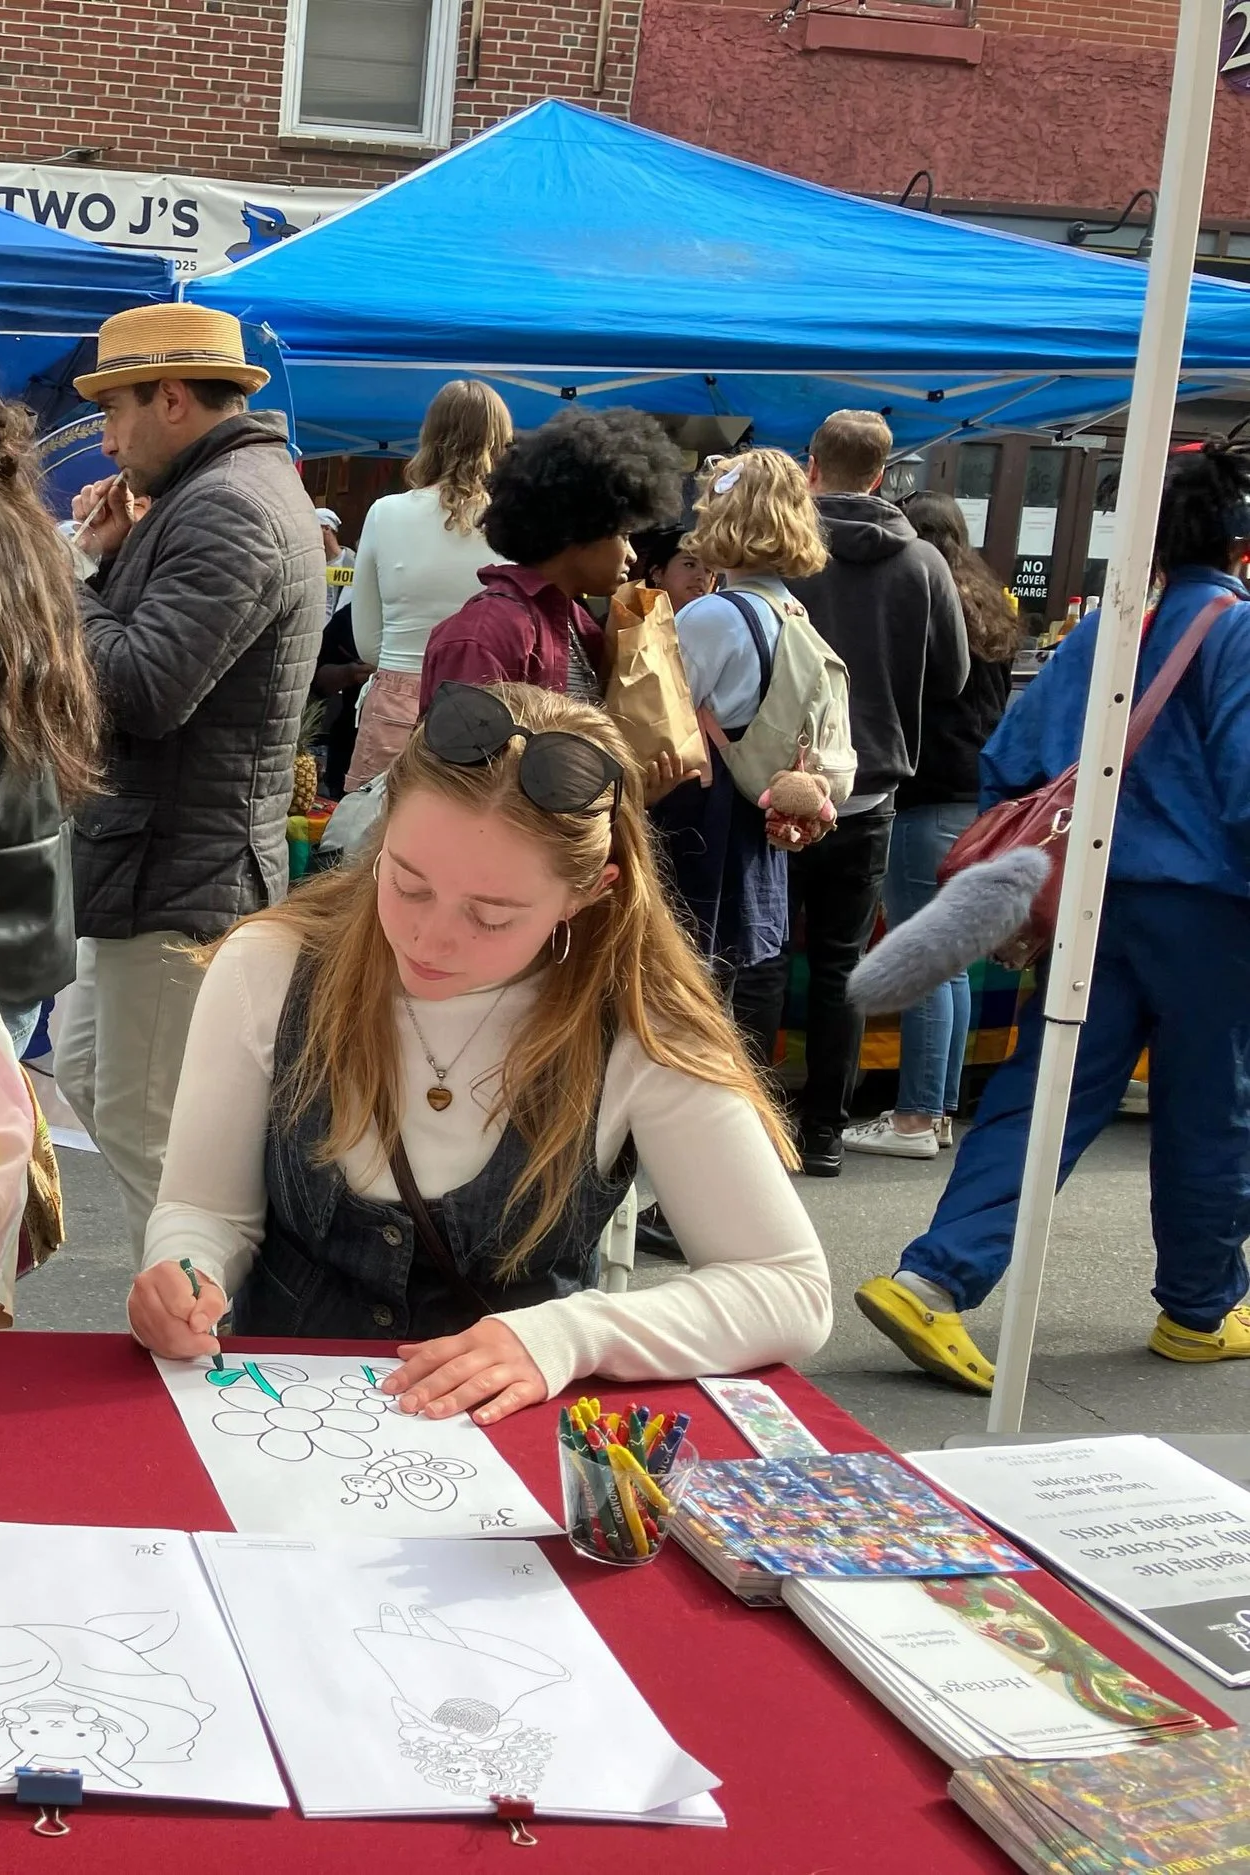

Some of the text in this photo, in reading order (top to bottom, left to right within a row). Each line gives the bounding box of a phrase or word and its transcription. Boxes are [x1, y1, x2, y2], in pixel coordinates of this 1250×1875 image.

[129, 196, 200, 238] J'S
[1022, 560, 1044, 573] NO
[1016, 574, 1046, 585] COVER
[1011, 586, 1048, 598] CHARGE
[1034, 1482, 1158, 1501] Tuesday June 9th
[605, 1481, 625, 1524] CRAYONS
[479, 1508, 517, 1531] 3rd
[1059, 1510, 1245, 1541] Emerging Artists
[135, 1543, 167, 1556] 3rd
[1108, 1539, 1184, 1558] Scene
[1174, 1534, 1218, 1550] Art
[1079, 1548, 1111, 1561] as
[1133, 1563, 1178, 1577] the
[938, 1677, 1031, 1697] Heritage
